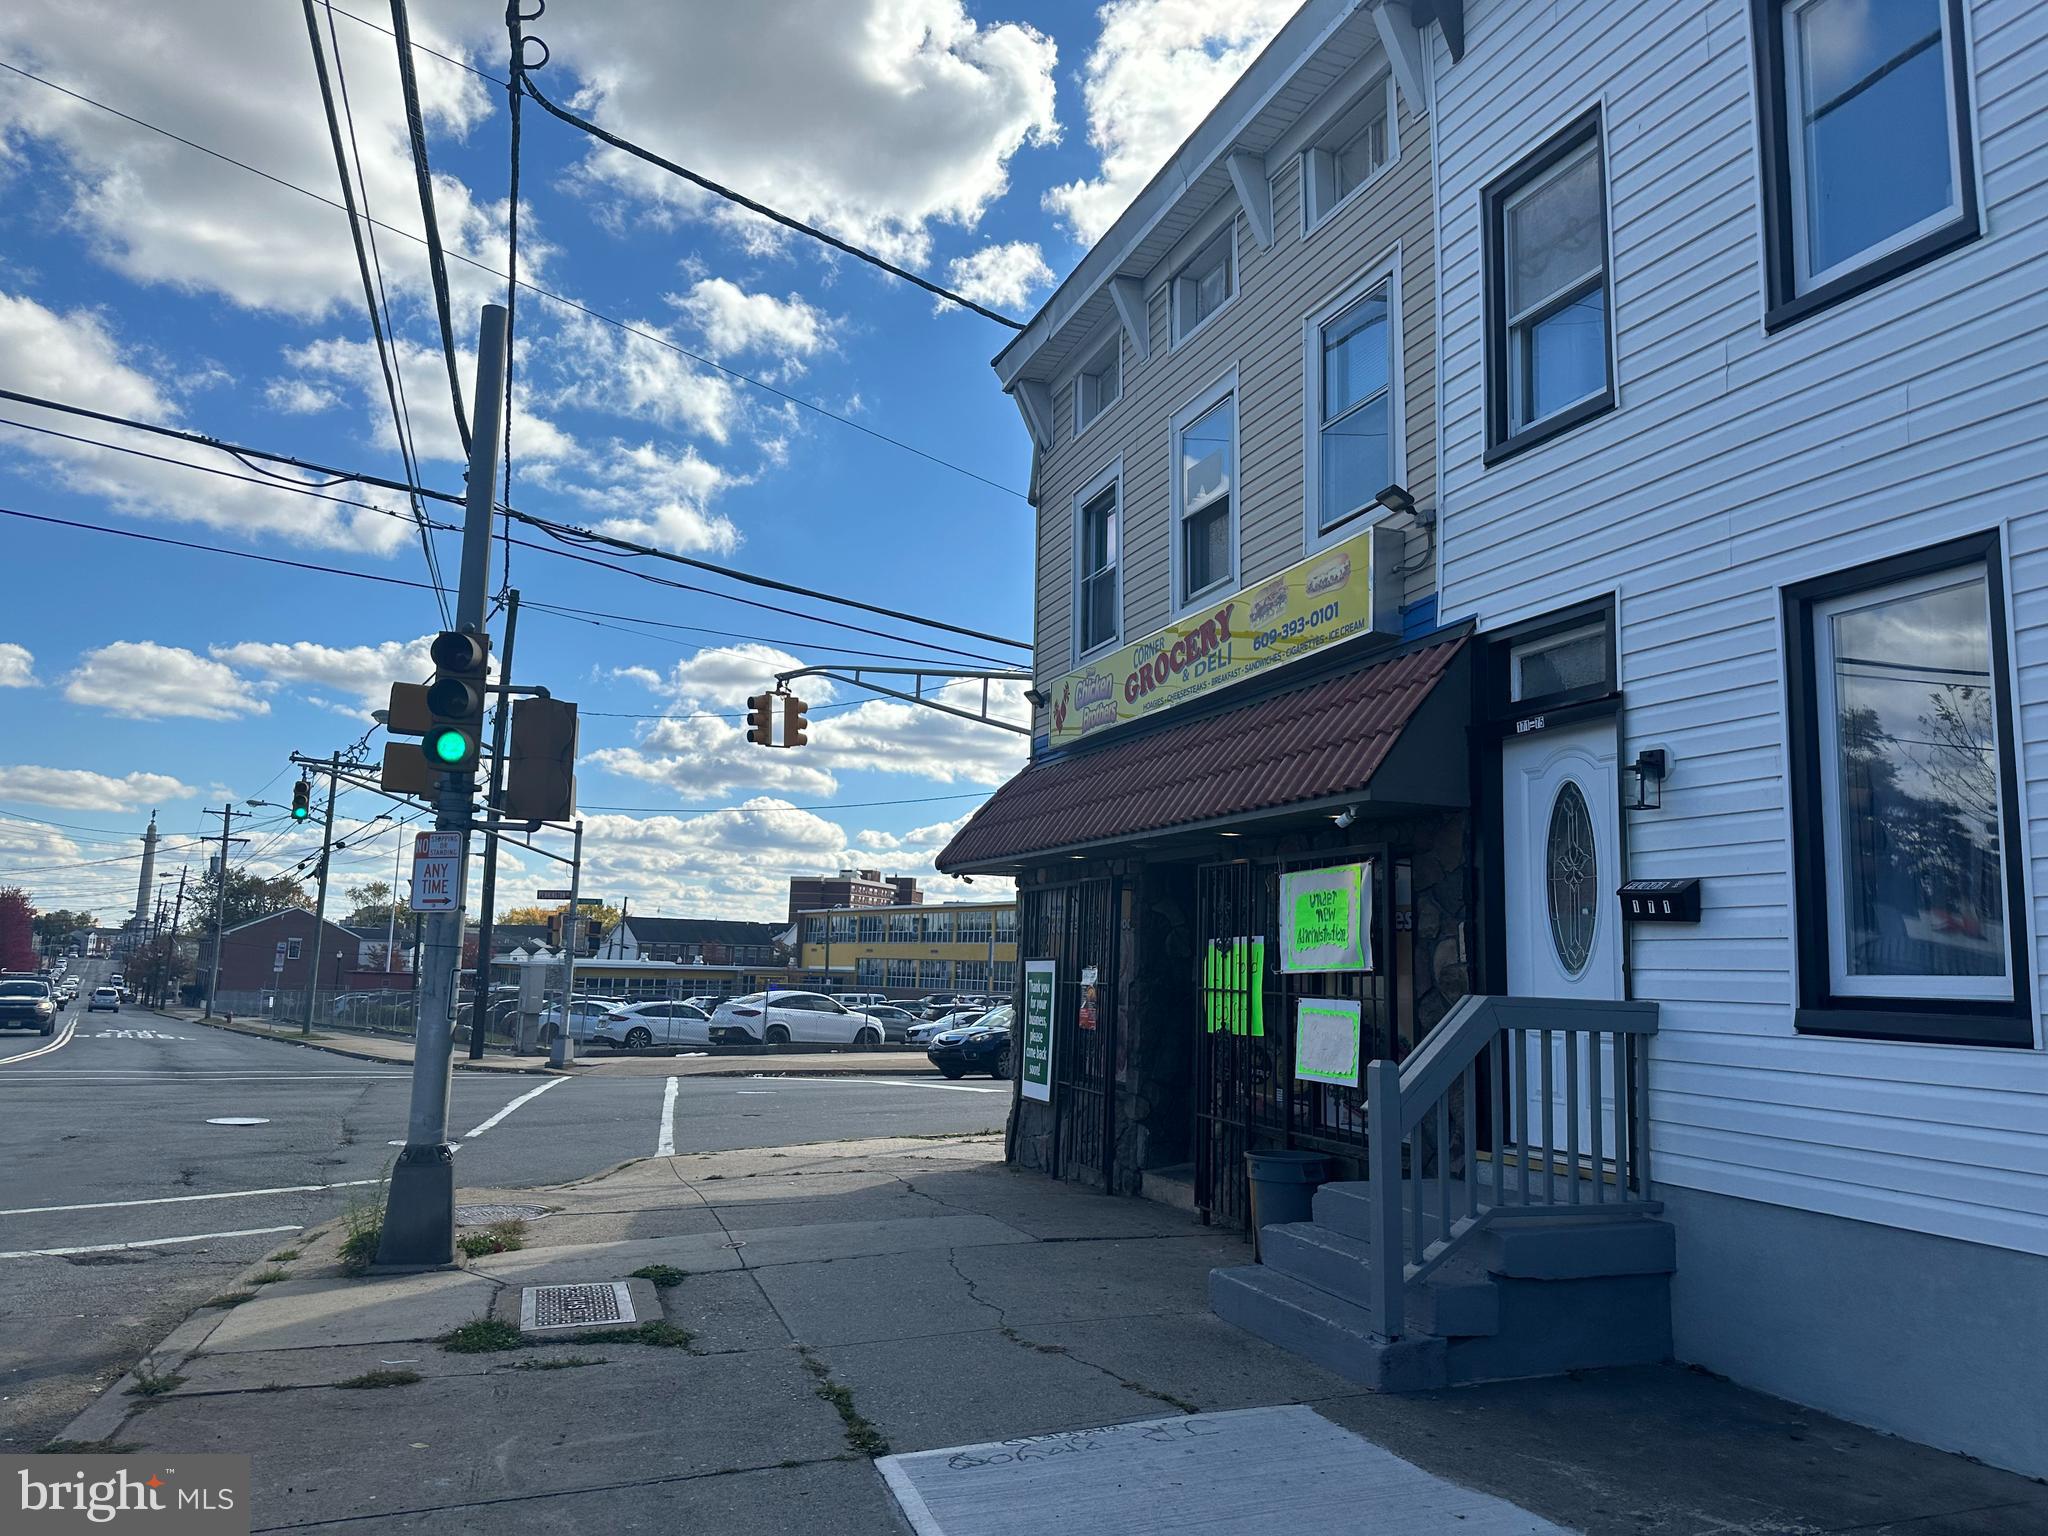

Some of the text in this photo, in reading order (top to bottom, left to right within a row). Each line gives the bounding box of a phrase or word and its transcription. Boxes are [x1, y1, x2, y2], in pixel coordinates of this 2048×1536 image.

[1253, 601, 1339, 651] 609-393-0101
[1124, 603, 1235, 704] GROCERY
[1133, 637, 1165, 669] CORNER
[1211, 667, 1241, 686] BREAKFAST
[1244, 652, 1282, 673] SANDWICHES
[1328, 628, 1339, 640] ICE
[1340, 618, 1365, 637] CREAM
[1182, 641, 1232, 682] & DELI
[1075, 673, 1114, 711] Chicken
[416, 838, 429, 854] NO
[423, 863, 448, 878] ANY
[422, 879, 448, 894] TIME
[1028, 979, 1050, 997] Thank you
[1036, 999, 1047, 1014] your
[1029, 1028, 1043, 1044] please
[1036, 1045, 1047, 1060] back
